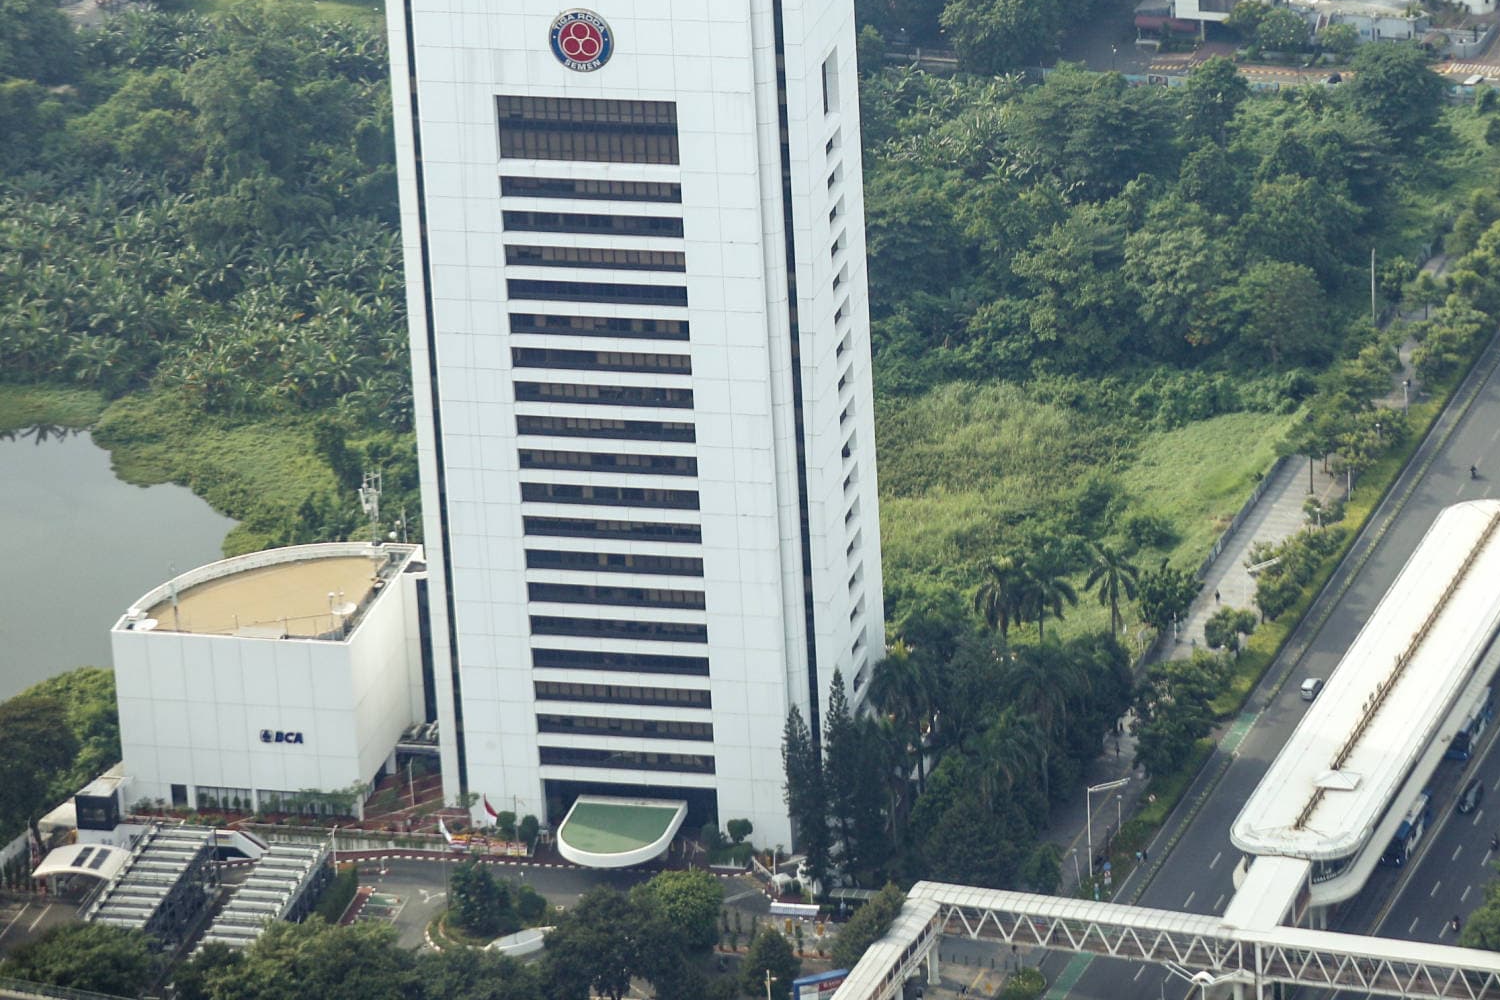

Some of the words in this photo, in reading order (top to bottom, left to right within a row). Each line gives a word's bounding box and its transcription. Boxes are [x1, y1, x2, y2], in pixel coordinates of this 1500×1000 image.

[554, 13, 576, 30] TIGA
[577, 13, 605, 33] RODA
[564, 58, 602, 71] SEMEN
[274, 730, 304, 744] BCA
